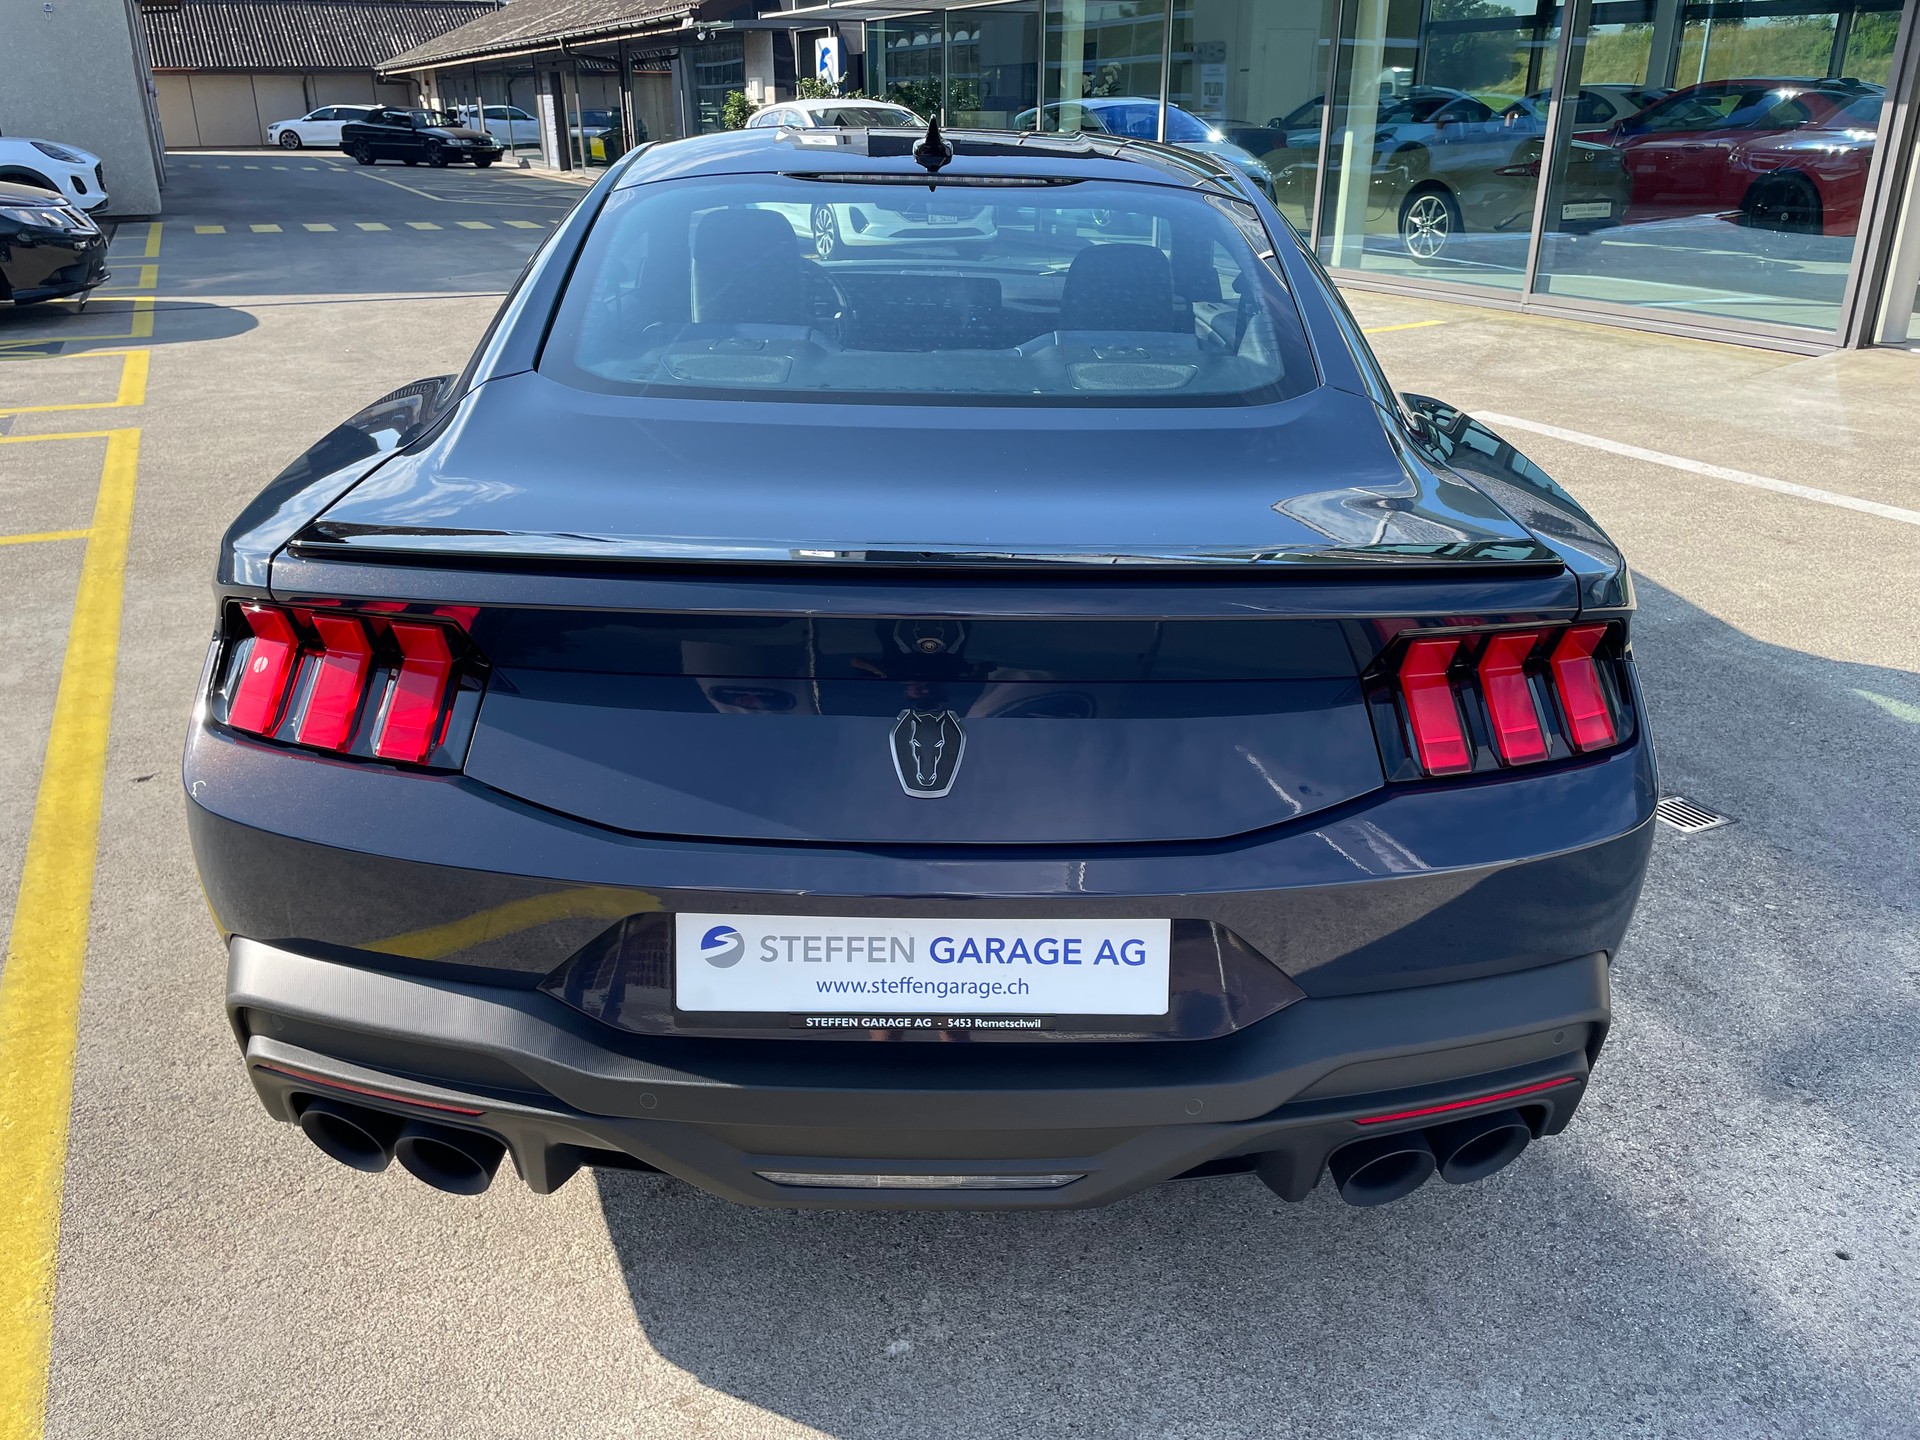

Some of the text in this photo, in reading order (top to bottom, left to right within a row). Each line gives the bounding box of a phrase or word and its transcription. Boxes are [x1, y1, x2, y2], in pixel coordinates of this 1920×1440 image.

[759, 934, 1147, 967] STEFFEN GARAGE AG
[816, 976, 1030, 999] www.steffengarage.ch
[805, 1017, 858, 1027] STEFFEN
[861, 1017, 912, 1028] GARAGE
[913, 1017, 932, 1028] AG
[947, 1018, 972, 1029] 5453
[974, 1018, 1042, 1029] Remetschwil
